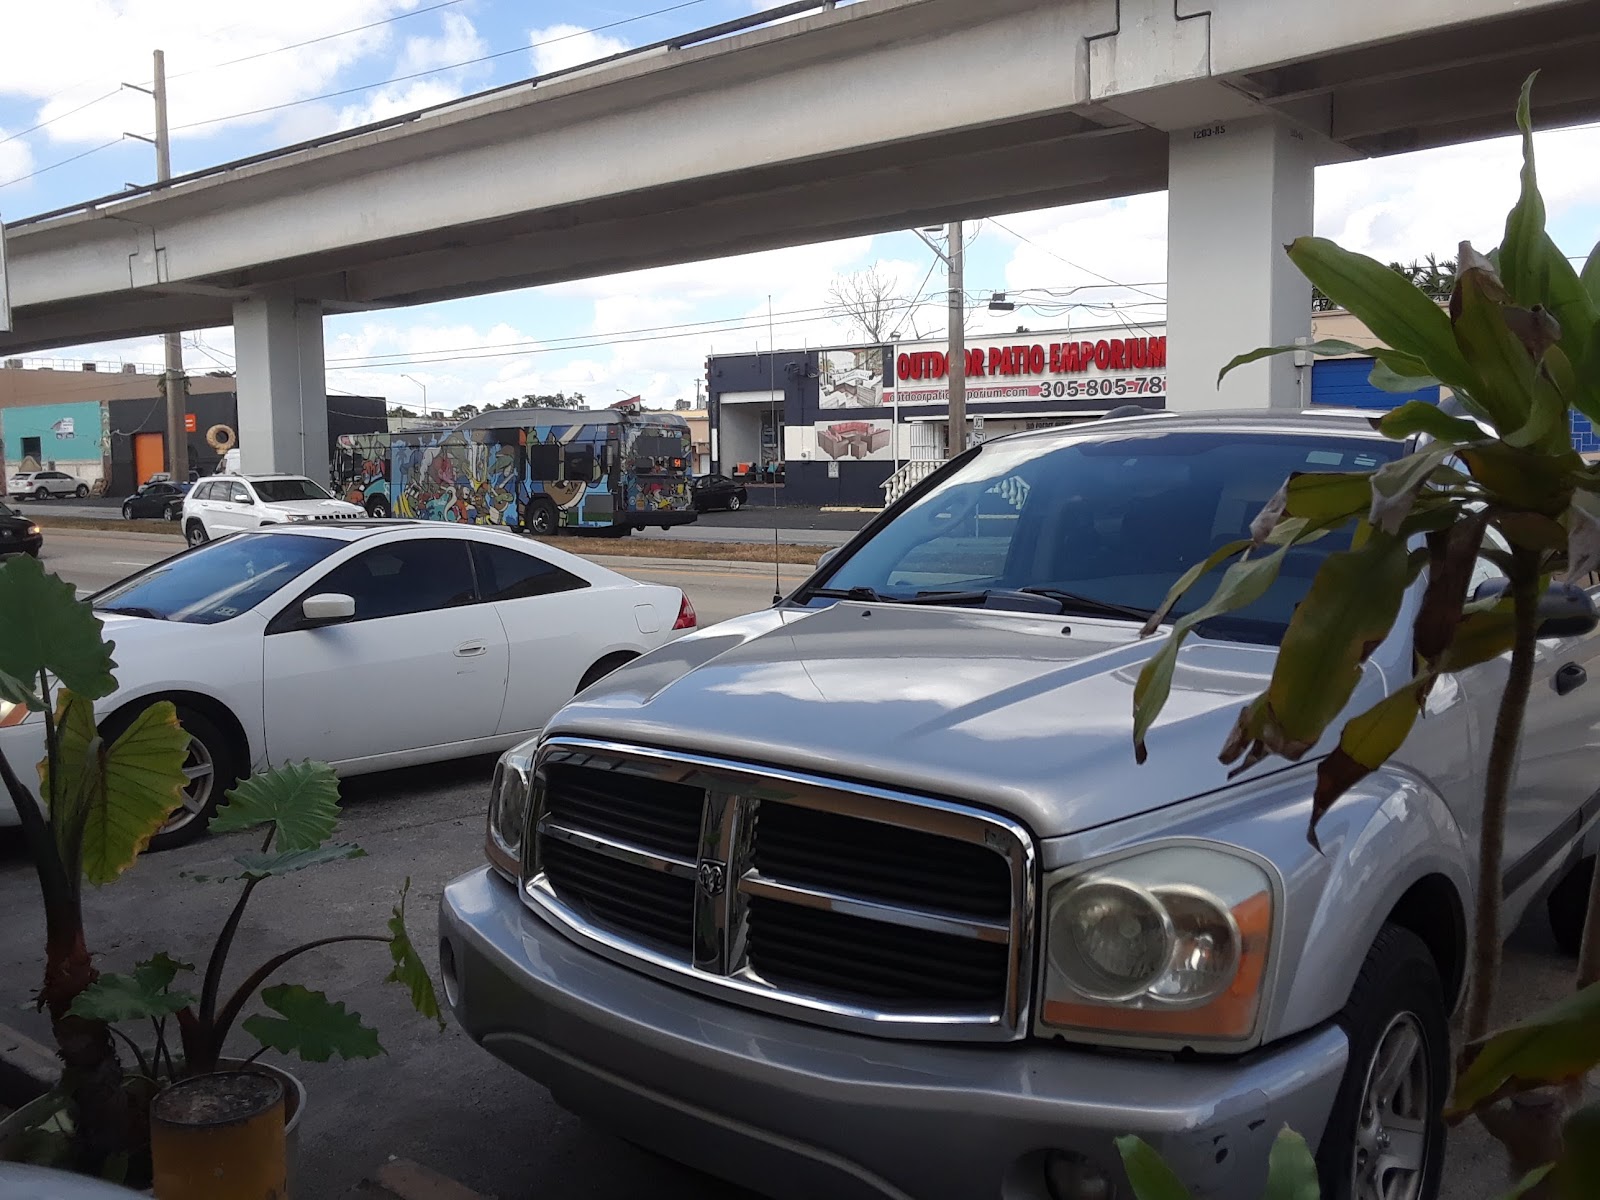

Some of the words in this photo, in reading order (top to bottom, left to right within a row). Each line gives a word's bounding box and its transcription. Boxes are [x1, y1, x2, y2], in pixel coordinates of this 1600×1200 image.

[988, 344, 1045, 376] PATIO
[1049, 336, 1167, 374] EMPORIUM
[889, 388, 1028, 403] outdoorpatioporium.com
[1039, 376, 1167, 398] 305-805-78
